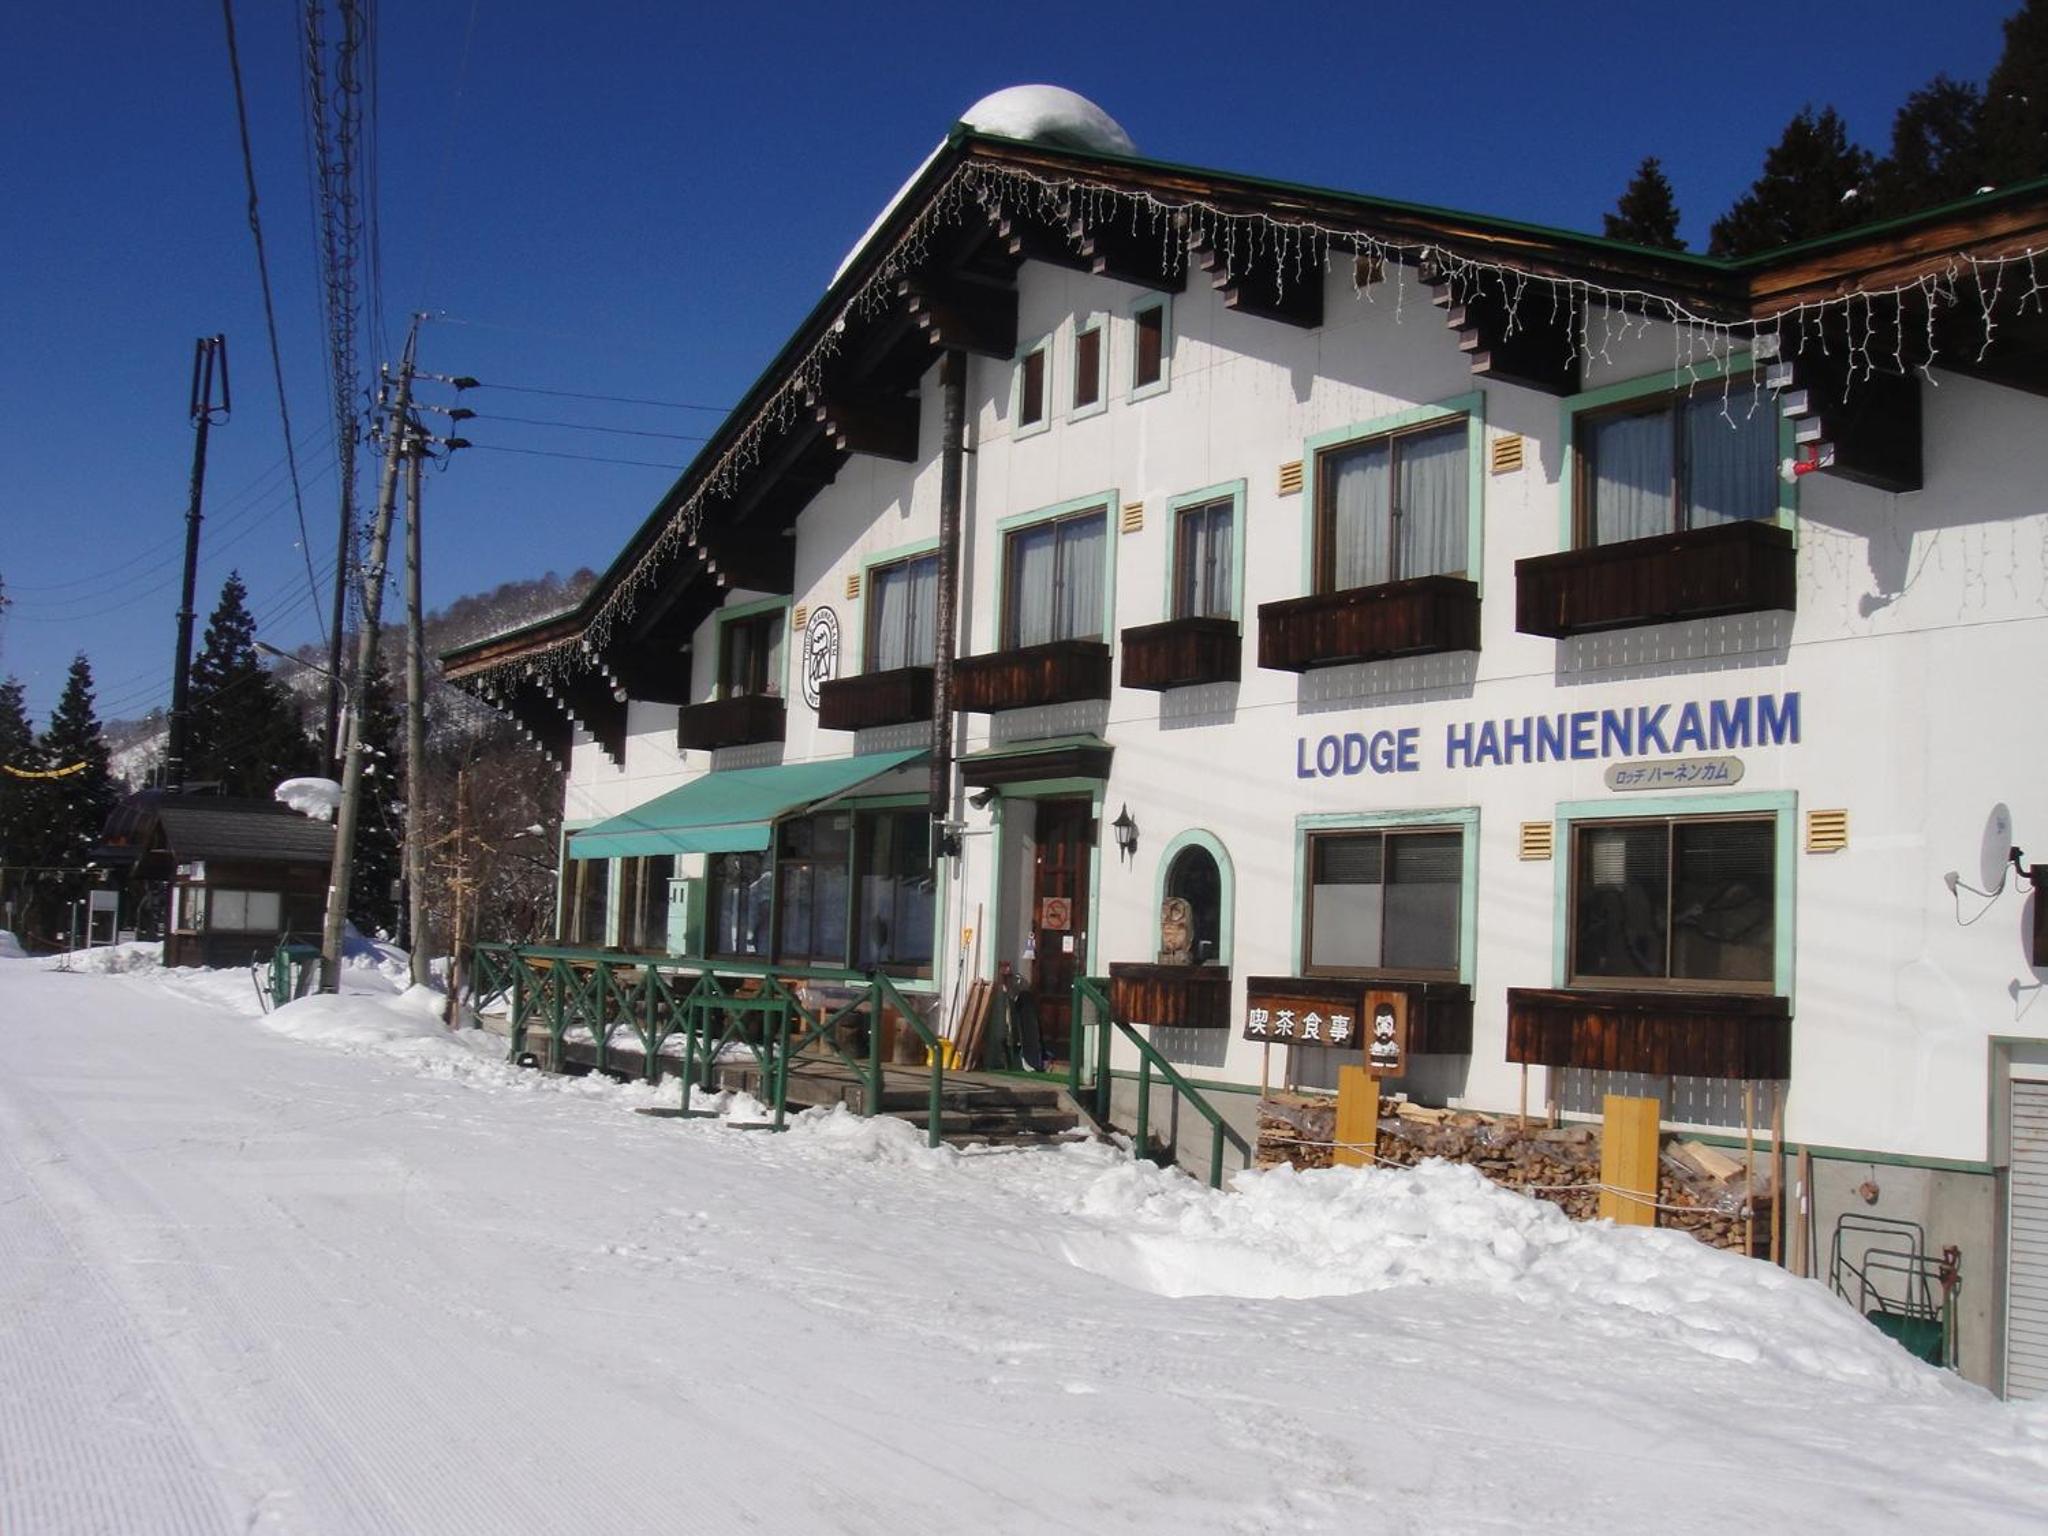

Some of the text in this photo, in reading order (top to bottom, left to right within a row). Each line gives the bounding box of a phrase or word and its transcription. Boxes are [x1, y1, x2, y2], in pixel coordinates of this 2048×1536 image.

[1297, 692, 1800, 778] LODGE HAHNENKAMM
[1249, 1007, 1350, 1042] 喫茶食事
